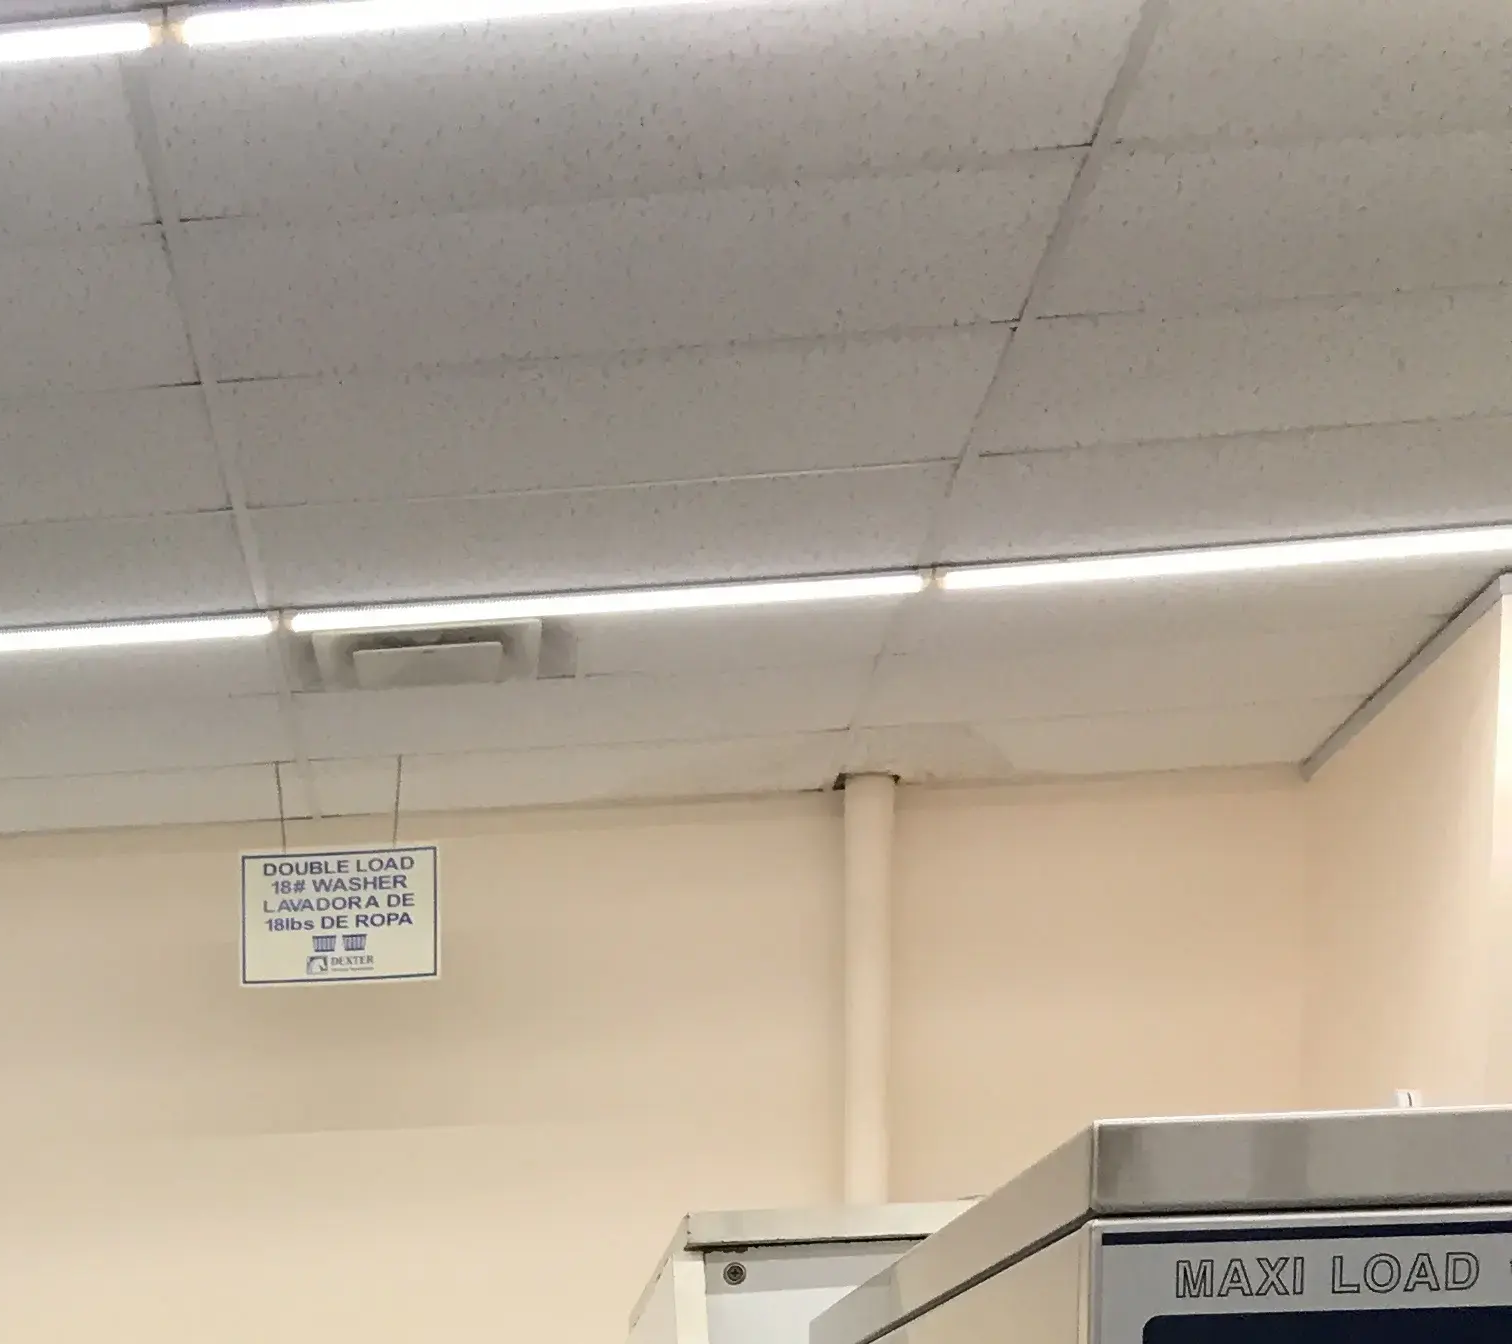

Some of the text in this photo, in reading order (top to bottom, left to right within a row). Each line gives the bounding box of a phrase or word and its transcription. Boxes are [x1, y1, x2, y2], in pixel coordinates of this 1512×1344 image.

[263, 856, 414, 876] DOUBLE LOAD
[272, 875, 407, 894] 18# WASHER
[263, 893, 415, 913] LAVADORA DE
[265, 912, 413, 931] 18lbs DE ROPA
[331, 955, 374, 966] DEXTER
[1176, 1252, 1480, 1298] MAXI LOAD
